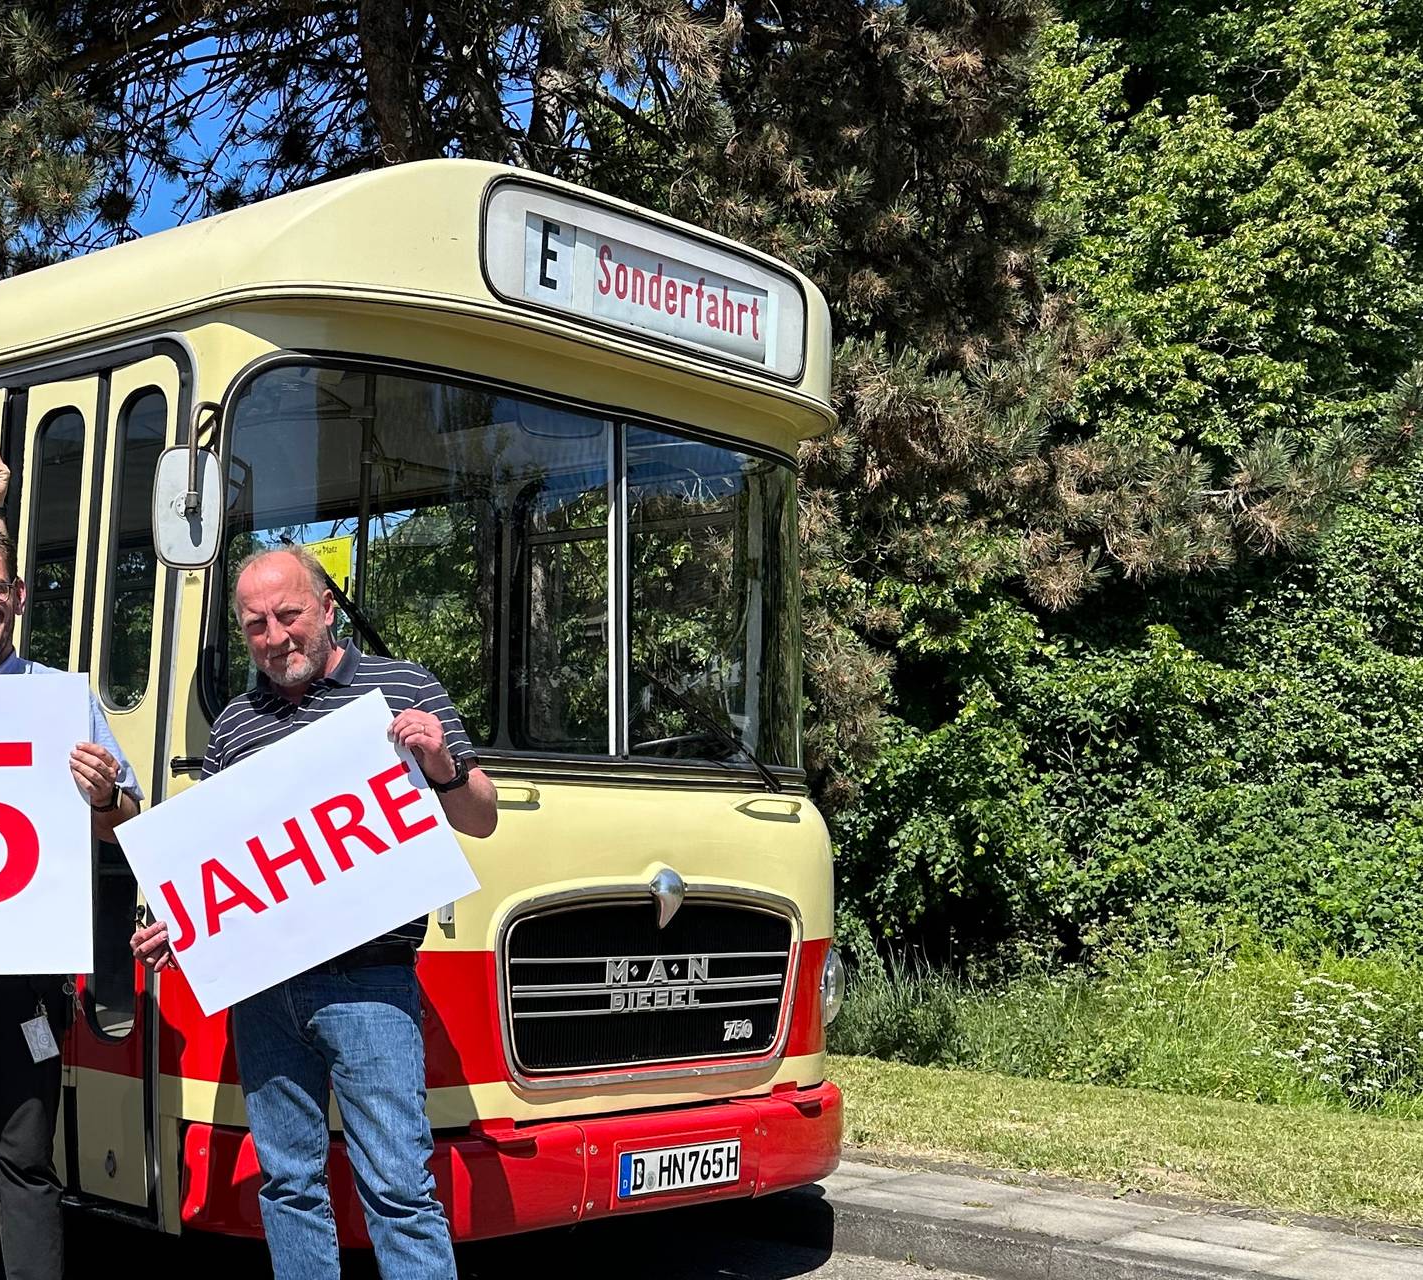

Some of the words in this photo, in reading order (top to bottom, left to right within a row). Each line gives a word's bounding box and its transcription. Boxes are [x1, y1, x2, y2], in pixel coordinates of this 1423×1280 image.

[539, 220, 560, 290] E
[597, 244, 759, 341] Sonderfahrt
[159, 761, 438, 953] JAHRE
[610, 988, 700, 1013] DIESEL
